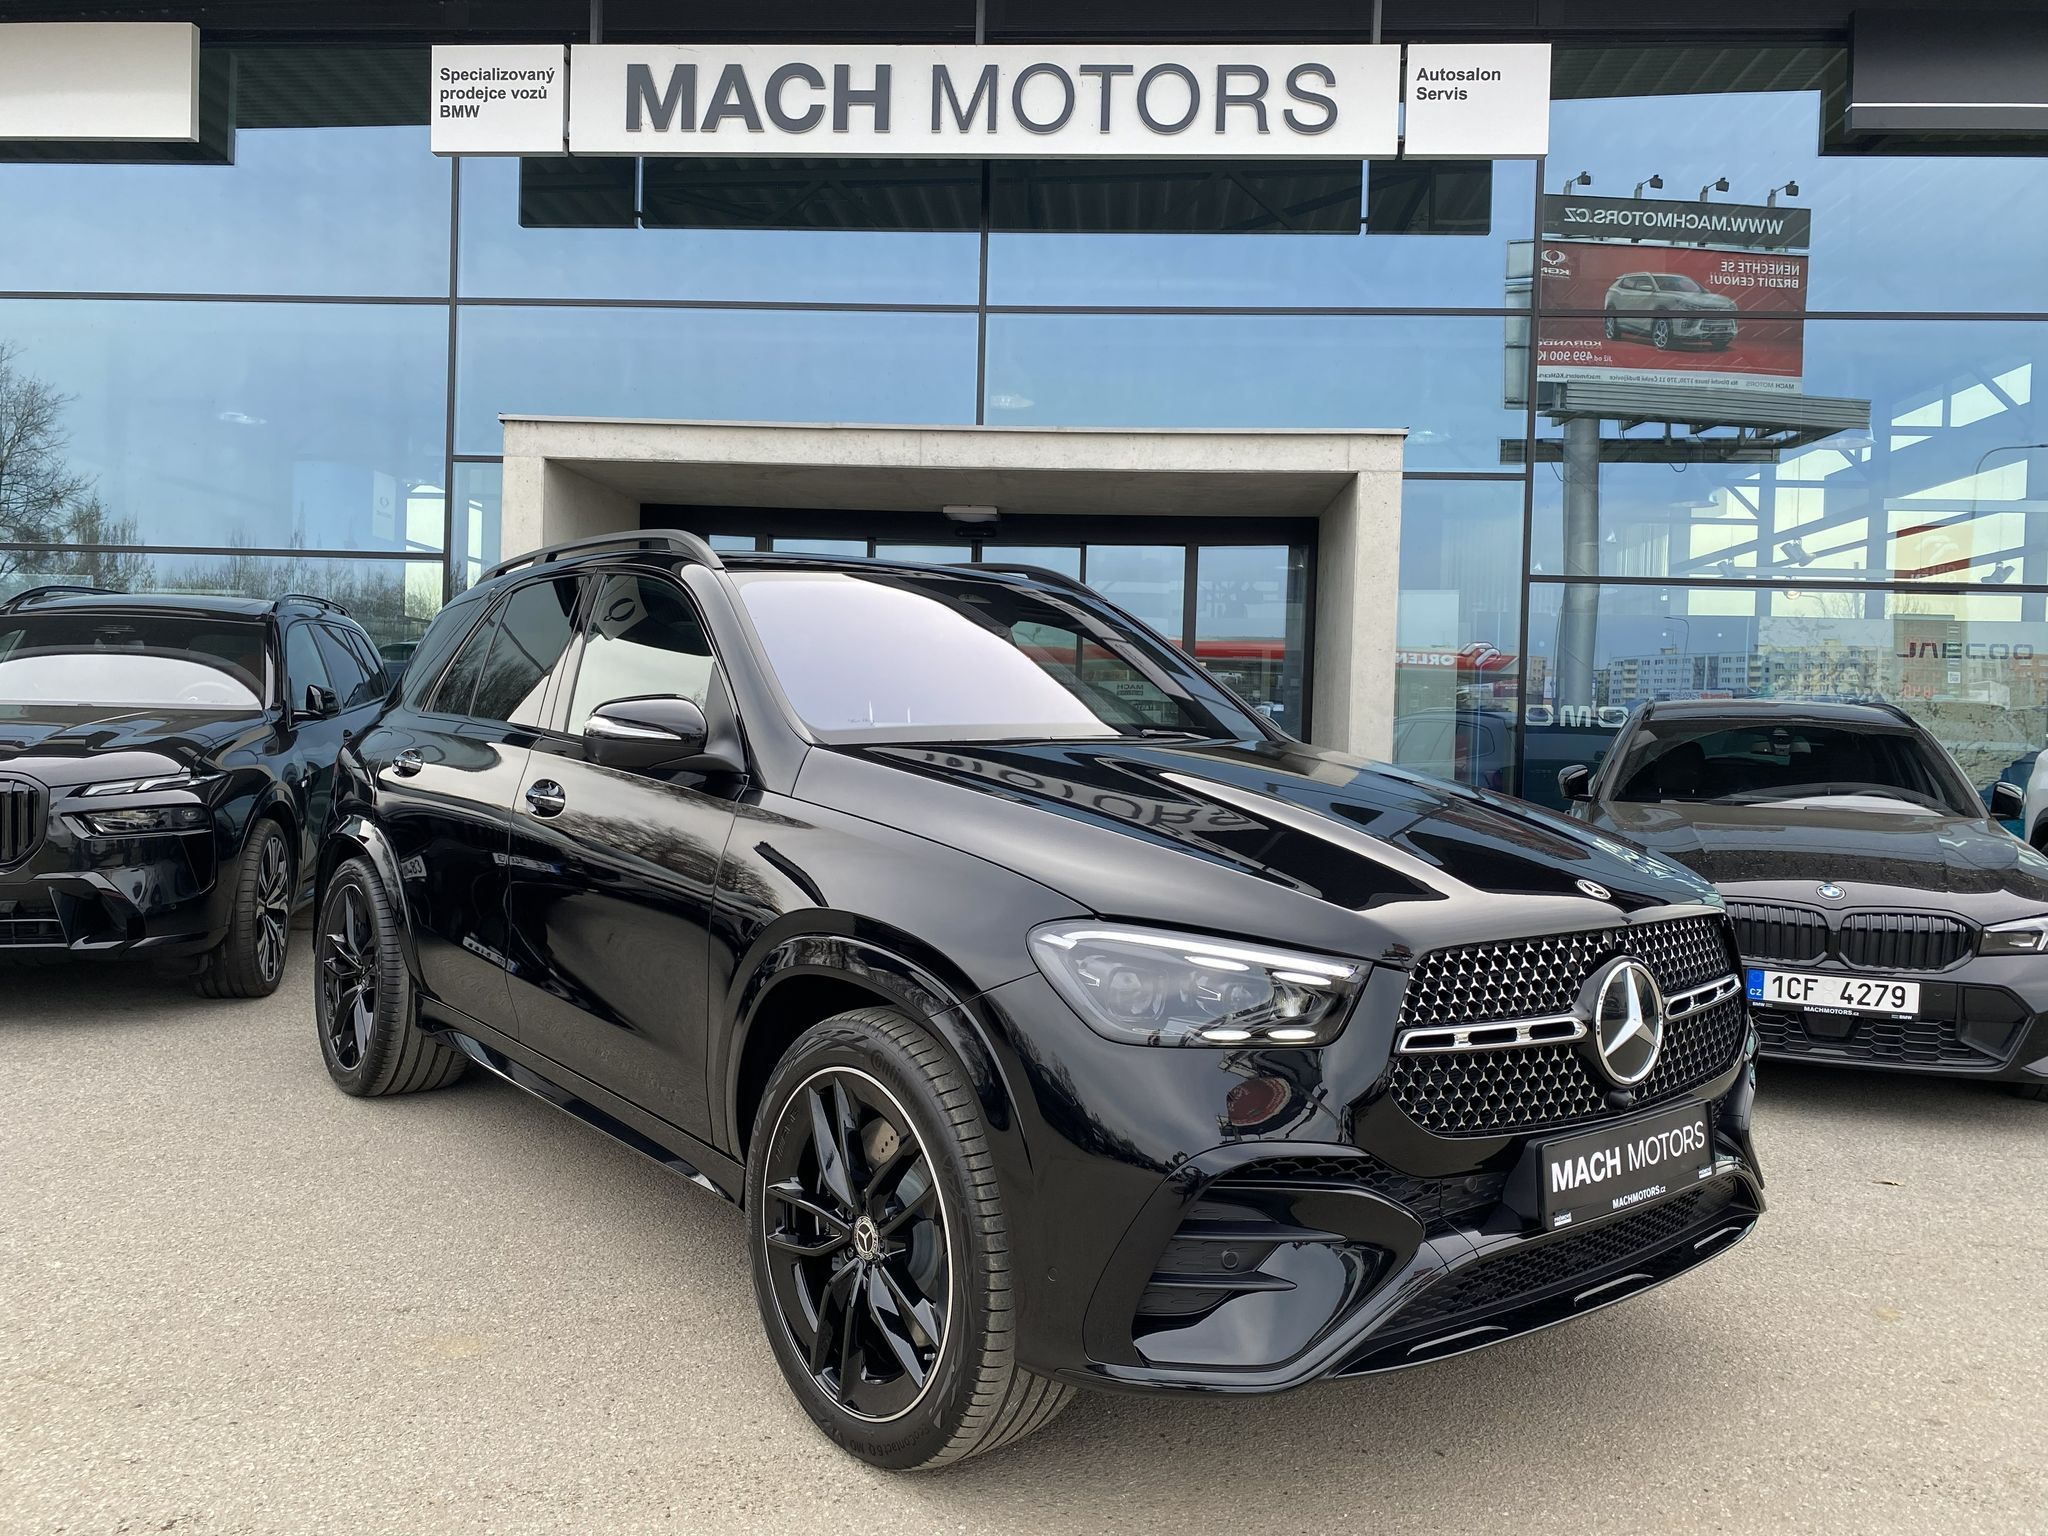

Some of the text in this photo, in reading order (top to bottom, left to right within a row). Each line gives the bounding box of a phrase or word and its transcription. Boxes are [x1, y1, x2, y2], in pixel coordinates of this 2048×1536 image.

[439, 67, 555, 84] Specializovaný
[1416, 67, 1502, 82] Autosalon
[439, 85, 548, 102] prodejce vozů
[625, 62, 1339, 135] MACH MOTORS
[1416, 86, 1468, 101] Servis
[439, 105, 480, 118] BMW
[1525, 704, 1629, 728] OMO
[1749, 975, 1906, 1009] CZ 1CF 4279
[1803, 1006, 1860, 1016] MACHMOTORS.cz
[1551, 1120, 1705, 1193] MACH MOTORS
[1612, 1185, 1666, 1209] MACHMOTORS.cz
